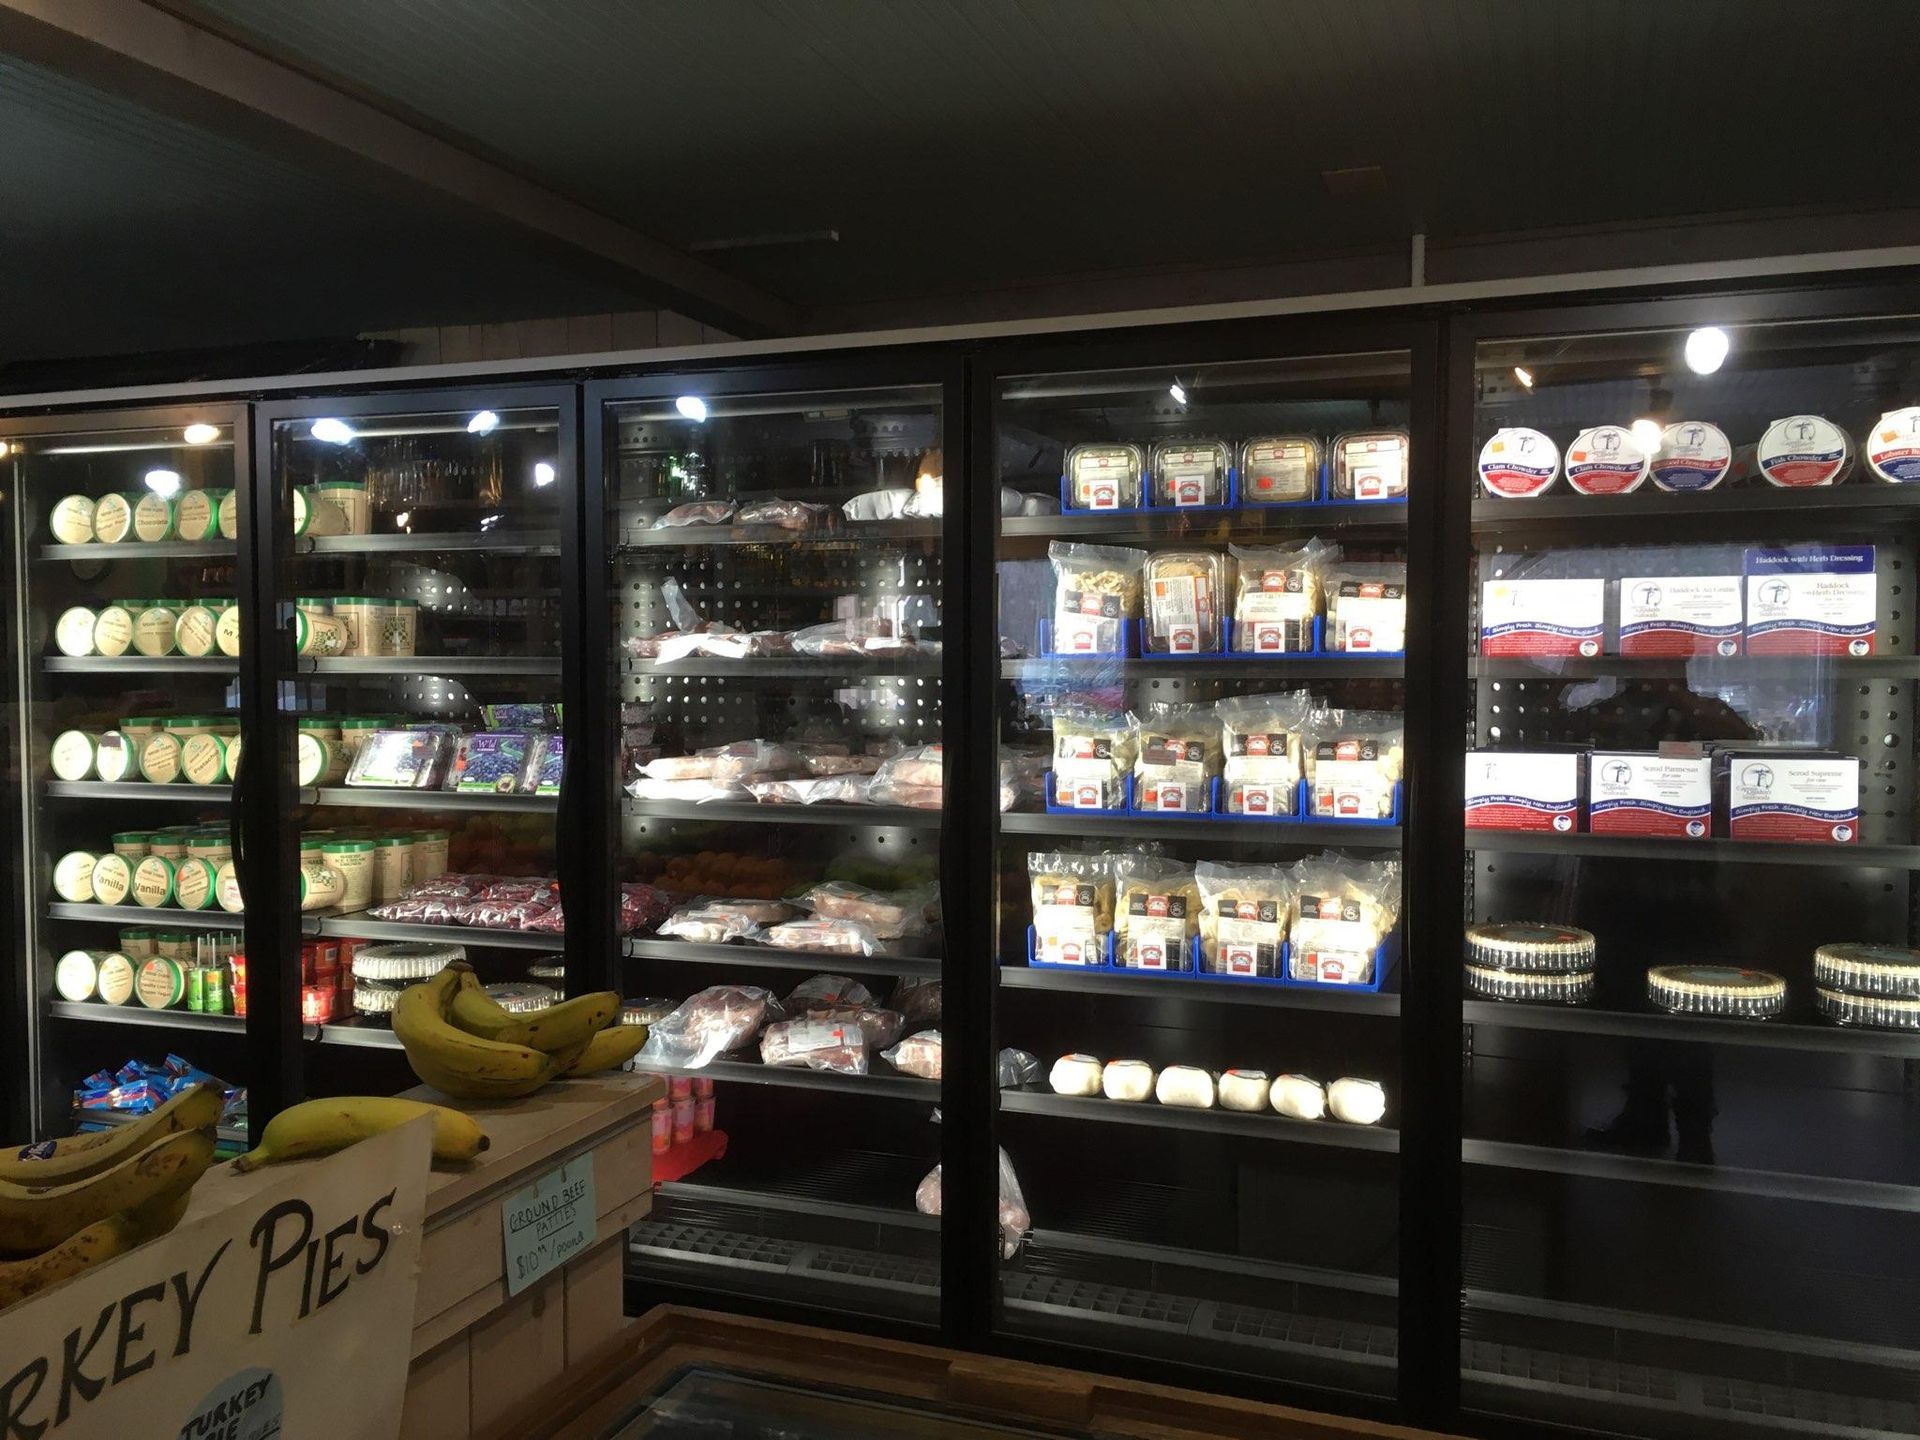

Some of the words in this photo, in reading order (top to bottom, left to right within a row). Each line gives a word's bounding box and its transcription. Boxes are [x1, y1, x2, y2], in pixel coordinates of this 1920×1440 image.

[1770, 456, 1785, 465] Fish
[1786, 454, 1823, 462] Chowder
[1880, 449, 1910, 460] Lobster
[1487, 463, 1506, 471] Clam
[1507, 463, 1538, 474] Chowder
[1575, 464, 1593, 473] Clam
[1594, 463, 1627, 472] Chowder
[1756, 556, 1789, 564] Haddock
[1790, 555, 1808, 563] with
[1809, 555, 1829, 563] Herb
[1830, 554, 1864, 562] Dressing
[134, 881, 167, 897] Vanilla
[509, 1194, 559, 1233] GROUND
[562, 1178, 586, 1203] BEEF
[535, 1203, 577, 1238] PATTIES
[248, 1187, 398, 1336] PIES
[180, 1372, 273, 1440] TURKEY
